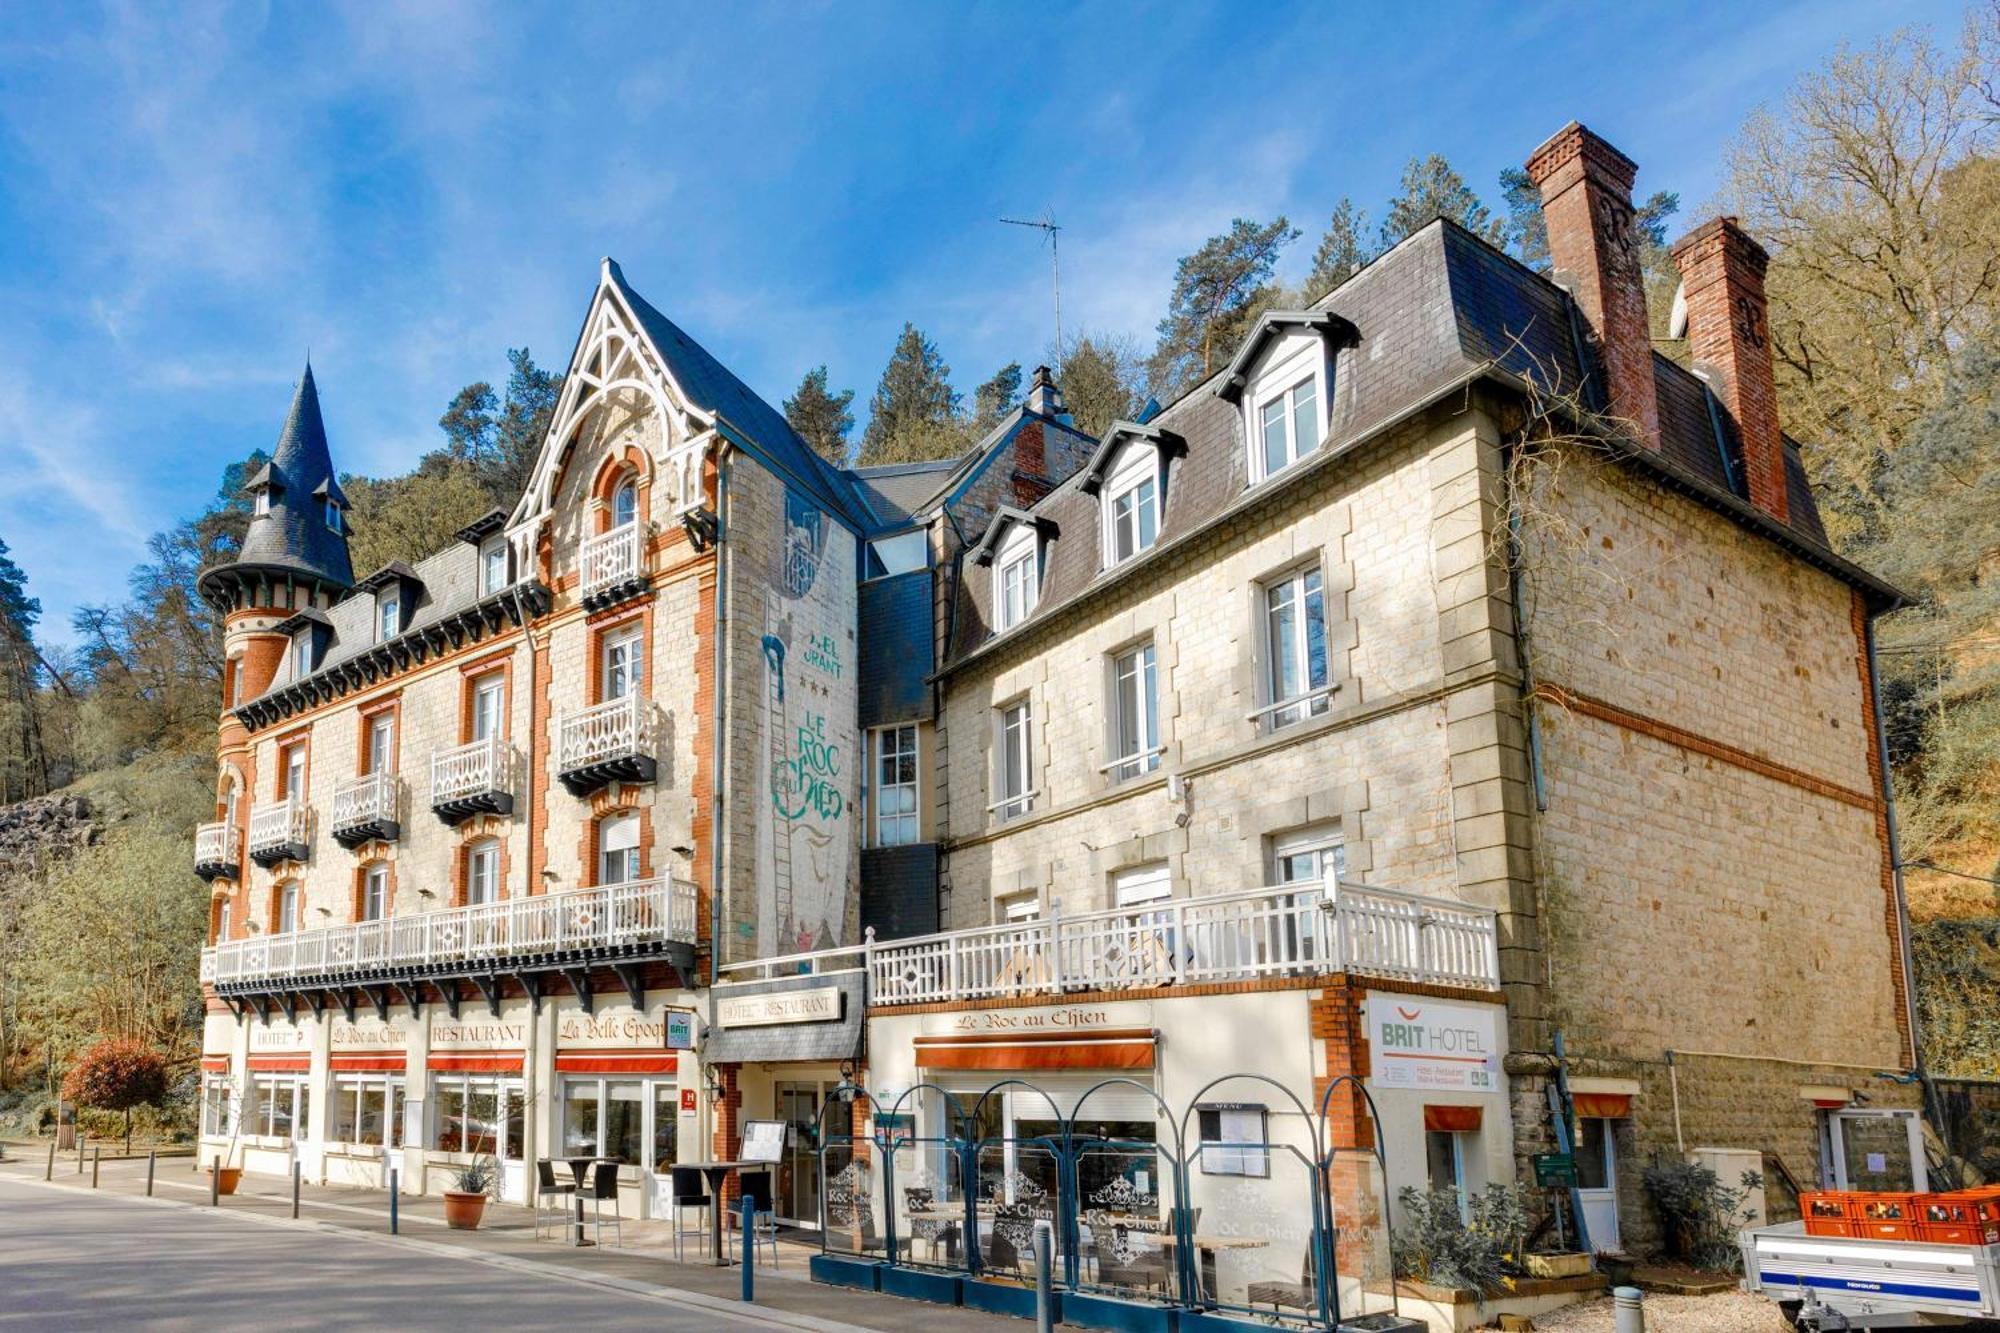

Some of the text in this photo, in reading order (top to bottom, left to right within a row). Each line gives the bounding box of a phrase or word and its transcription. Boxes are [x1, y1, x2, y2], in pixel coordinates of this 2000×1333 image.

[806, 710, 826, 740] LE
[798, 727, 841, 776] ROC
[560, 1018, 580, 1039] La
[585, 1016, 619, 1039] Belle
[670, 1024, 689, 1034] BRIT
[954, 1009, 1107, 1029] Le Roc au Chien
[433, 1024, 525, 1042] RESTAURANT
[1382, 1023, 1487, 1053] BRIT HOTEL
[687, 1092, 694, 1101] H
